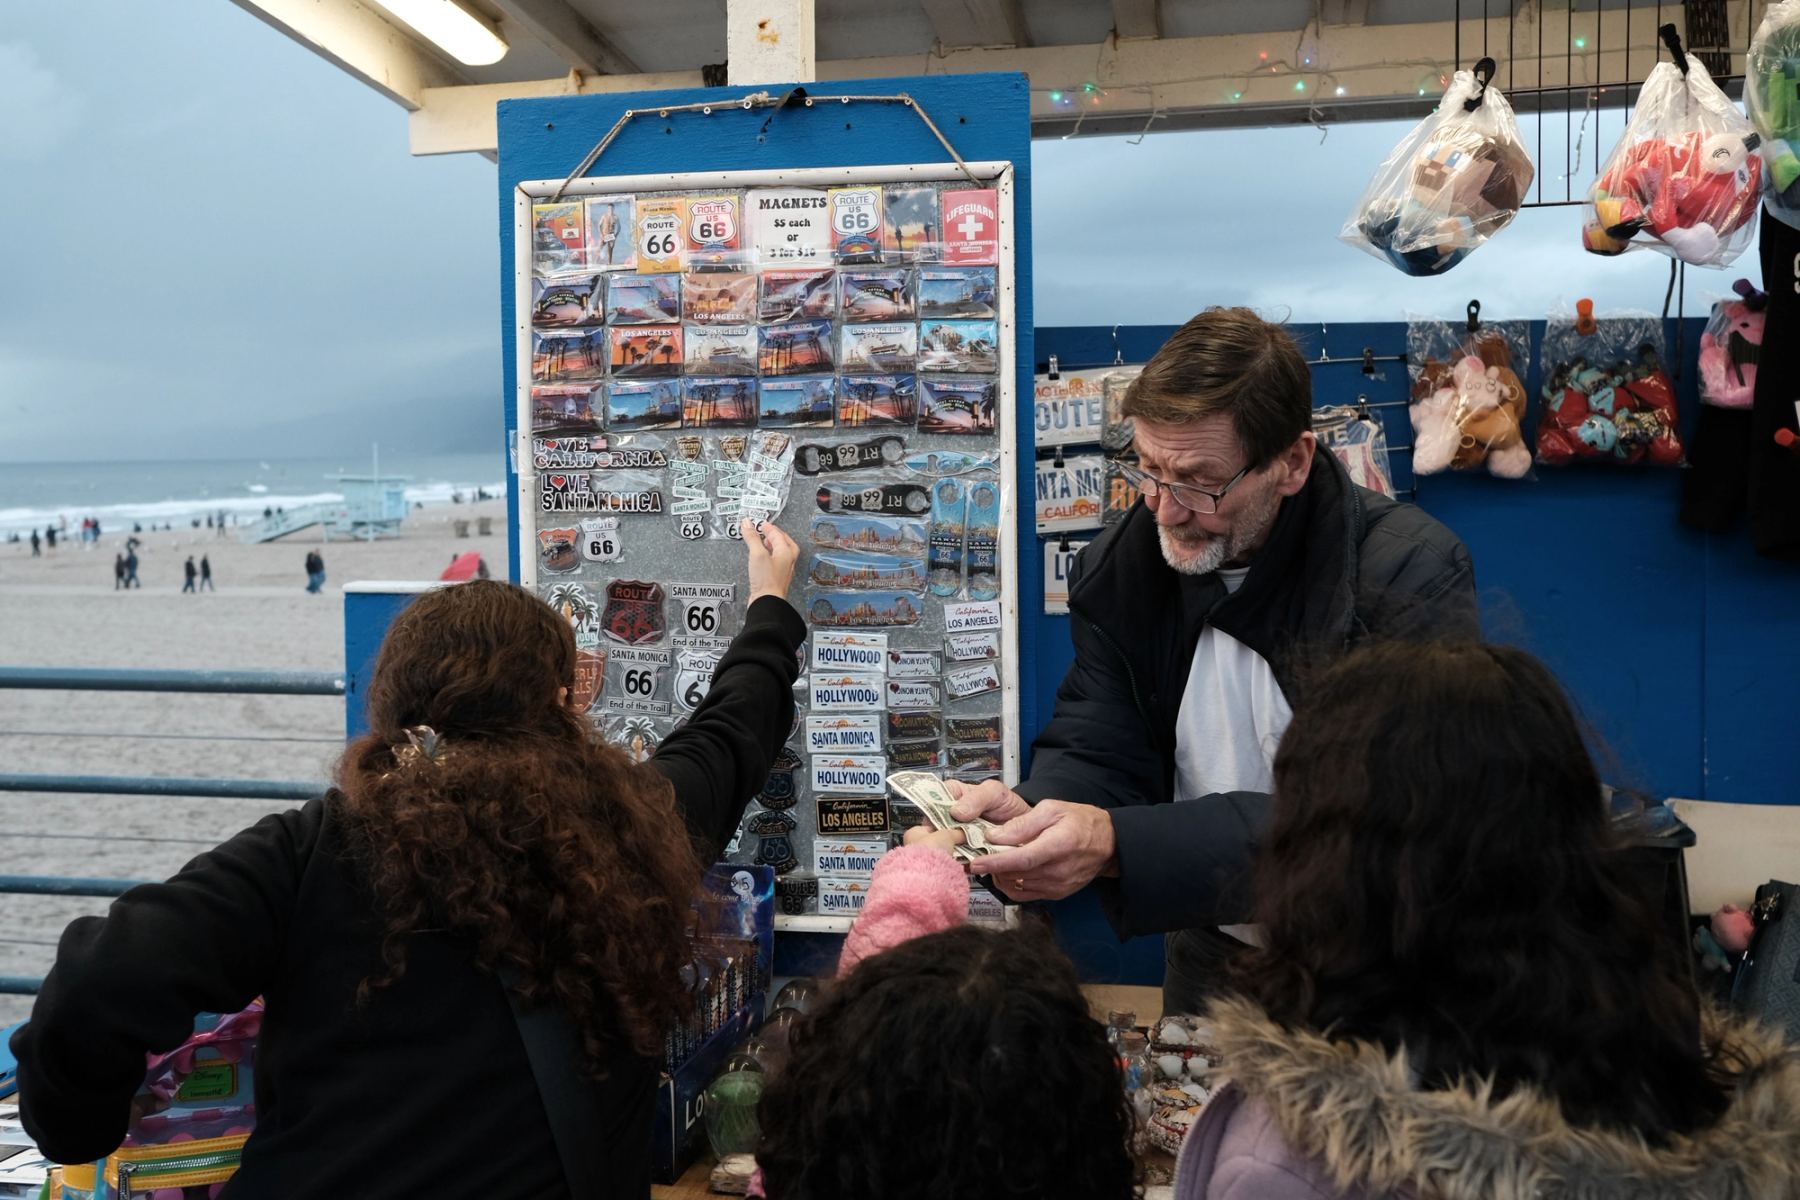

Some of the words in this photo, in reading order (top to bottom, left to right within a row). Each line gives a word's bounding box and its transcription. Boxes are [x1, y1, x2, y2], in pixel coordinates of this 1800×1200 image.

[759, 197, 828, 210] MAGNETS
[839, 195, 869, 205] ROUTE
[697, 205, 727, 214] ROUTE
[946, 203, 994, 224] LIFEGUARD
[647, 221, 675, 229] ROUTE
[788, 218, 811, 228] each
[842, 212, 869, 229] 66
[700, 222, 726, 238] 66
[786, 232, 799, 242] or
[647, 233, 676, 254] 66
[779, 248, 795, 257] for
[693, 312, 709, 320] LOS
[709, 312, 746, 320] ANGELES
[620, 329, 636, 337] LOS
[635, 329, 672, 337] ANGELES
[851, 327, 870, 335] LOS
[869, 326, 906, 334] ANGELES
[1035, 401, 1102, 431] OUTE
[839, 446, 856, 459] 66
[863, 447, 879, 460] RT
[534, 450, 667, 469] CALIFORNIA
[819, 453, 833, 465] 66
[1037, 471, 1068, 501] NTA
[842, 495, 856, 506] 66
[863, 490, 880, 502] 66
[886, 495, 902, 507] RT
[674, 504, 689, 512] SANTA
[690, 502, 708, 510] MONICA
[719, 504, 734, 512] SANTA
[683, 523, 701, 537] 66
[590, 540, 614, 555] 66
[615, 587, 654, 599] ROUTE
[672, 587, 697, 597] SANTA
[699, 588, 731, 598] MONICA
[955, 606, 992, 618] California
[610, 608, 654, 635] 66
[687, 605, 715, 632] 66
[948, 619, 963, 629] LOS
[964, 617, 999, 628] ANGELES
[672, 638, 686, 646] End
[687, 638, 697, 647] of
[698, 639, 711, 647] the
[712, 640, 730, 648] Trail
[611, 650, 636, 660] SANTA
[638, 651, 669, 662] MONICA
[818, 647, 881, 664] HOLLYWOOD
[689, 659, 718, 670] ROUT
[574, 668, 598, 680] ERLY
[574, 682, 592, 694] LLS
[625, 669, 653, 695] 66
[815, 688, 879, 703] HOLLYWOOD
[609, 701, 623, 709] End
[624, 701, 635, 710] of
[636, 702, 649, 710] the
[649, 702, 666, 712] Trail
[812, 731, 839, 745] SANTA
[841, 730, 875, 745] MONICA
[817, 769, 880, 786] HOLLYWOOD
[822, 813, 840, 827] LOS
[842, 811, 884, 826] ANGELES
[819, 856, 846, 870] SANTA
[847, 856, 880, 870] MONIC
[823, 895, 850, 908] SANTA
[968, 908, 1001, 917] ANGELES
